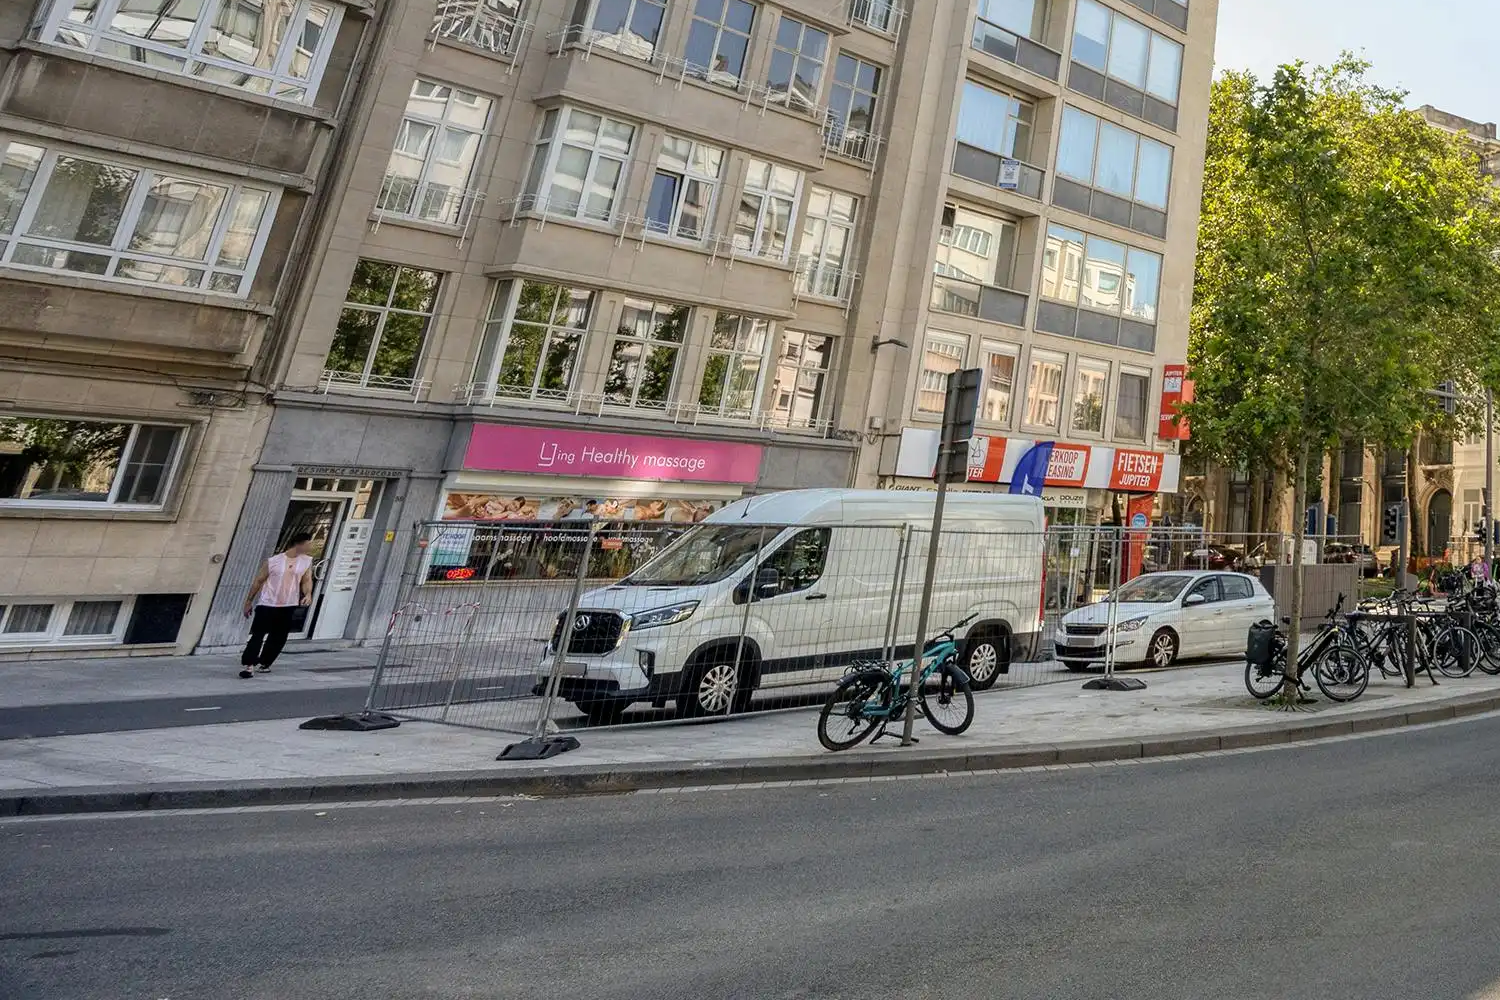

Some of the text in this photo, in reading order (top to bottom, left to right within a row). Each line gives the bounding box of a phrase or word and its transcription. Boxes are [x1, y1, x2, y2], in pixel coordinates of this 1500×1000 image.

[581, 446, 639, 468] Healthy
[643, 453, 706, 472] massage
[1049, 450, 1079, 465] ERKOOP
[1117, 452, 1158, 474] FIETSEN
[968, 467, 984, 478] TER
[1047, 464, 1075, 479] EASING
[1118, 474, 1151, 487] JUPITER
[543, 533, 598, 543] hoofdmassae
